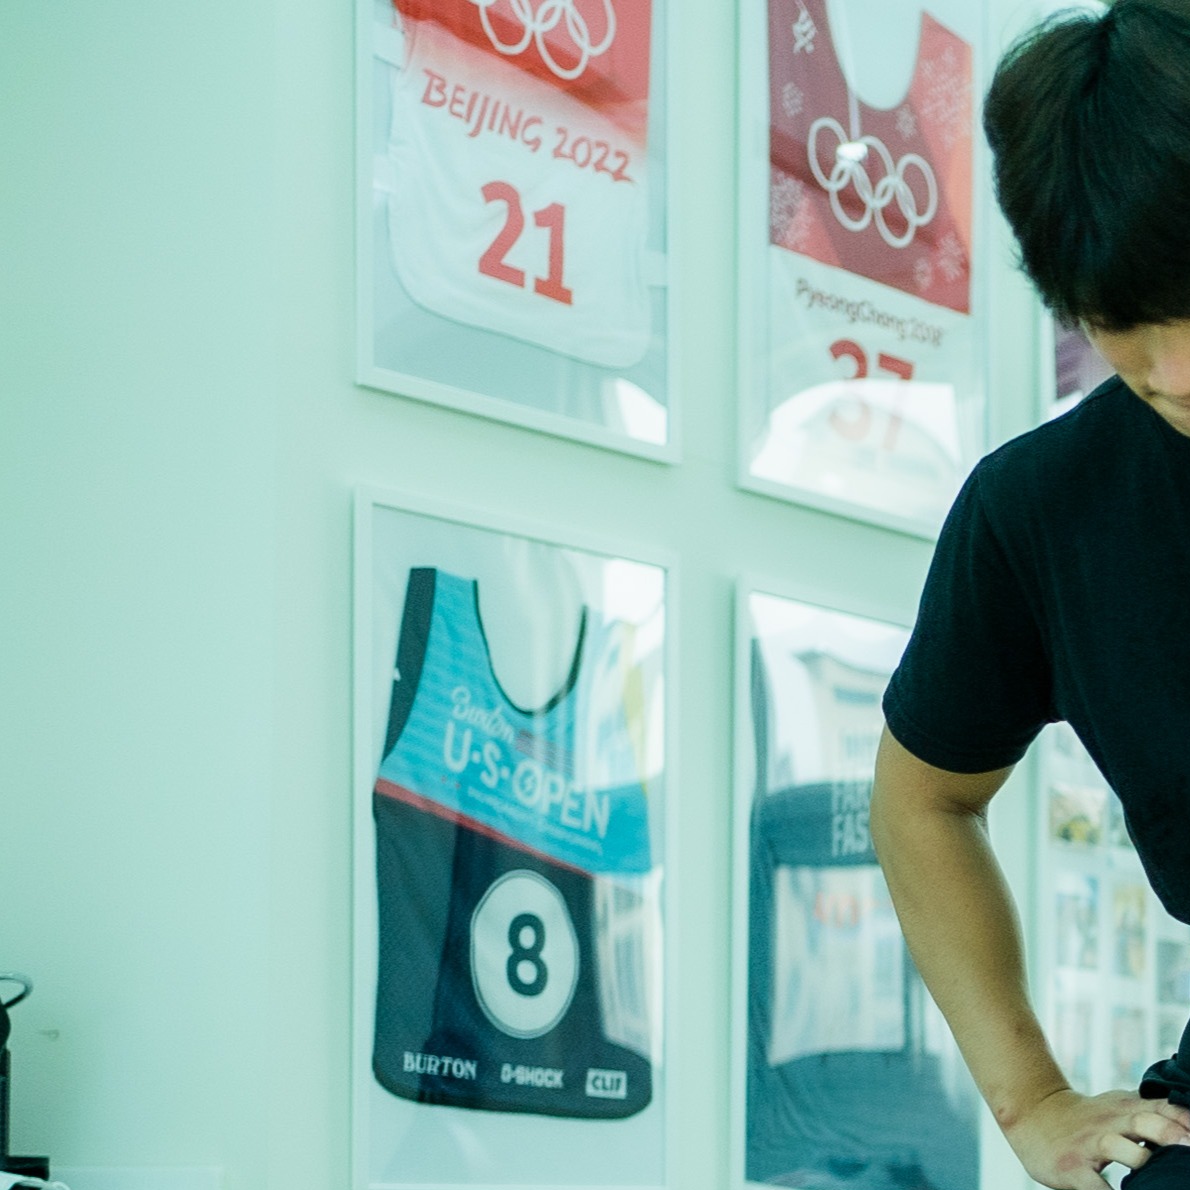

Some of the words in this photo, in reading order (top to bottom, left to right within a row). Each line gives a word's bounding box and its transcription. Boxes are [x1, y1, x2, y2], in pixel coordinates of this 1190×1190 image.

[422, 68, 544, 153] BEIJING
[553, 127, 634, 183] 2022
[478, 180, 573, 305] 21
[506, 912, 549, 997] 8
[403, 1050, 478, 1080] BURTON
